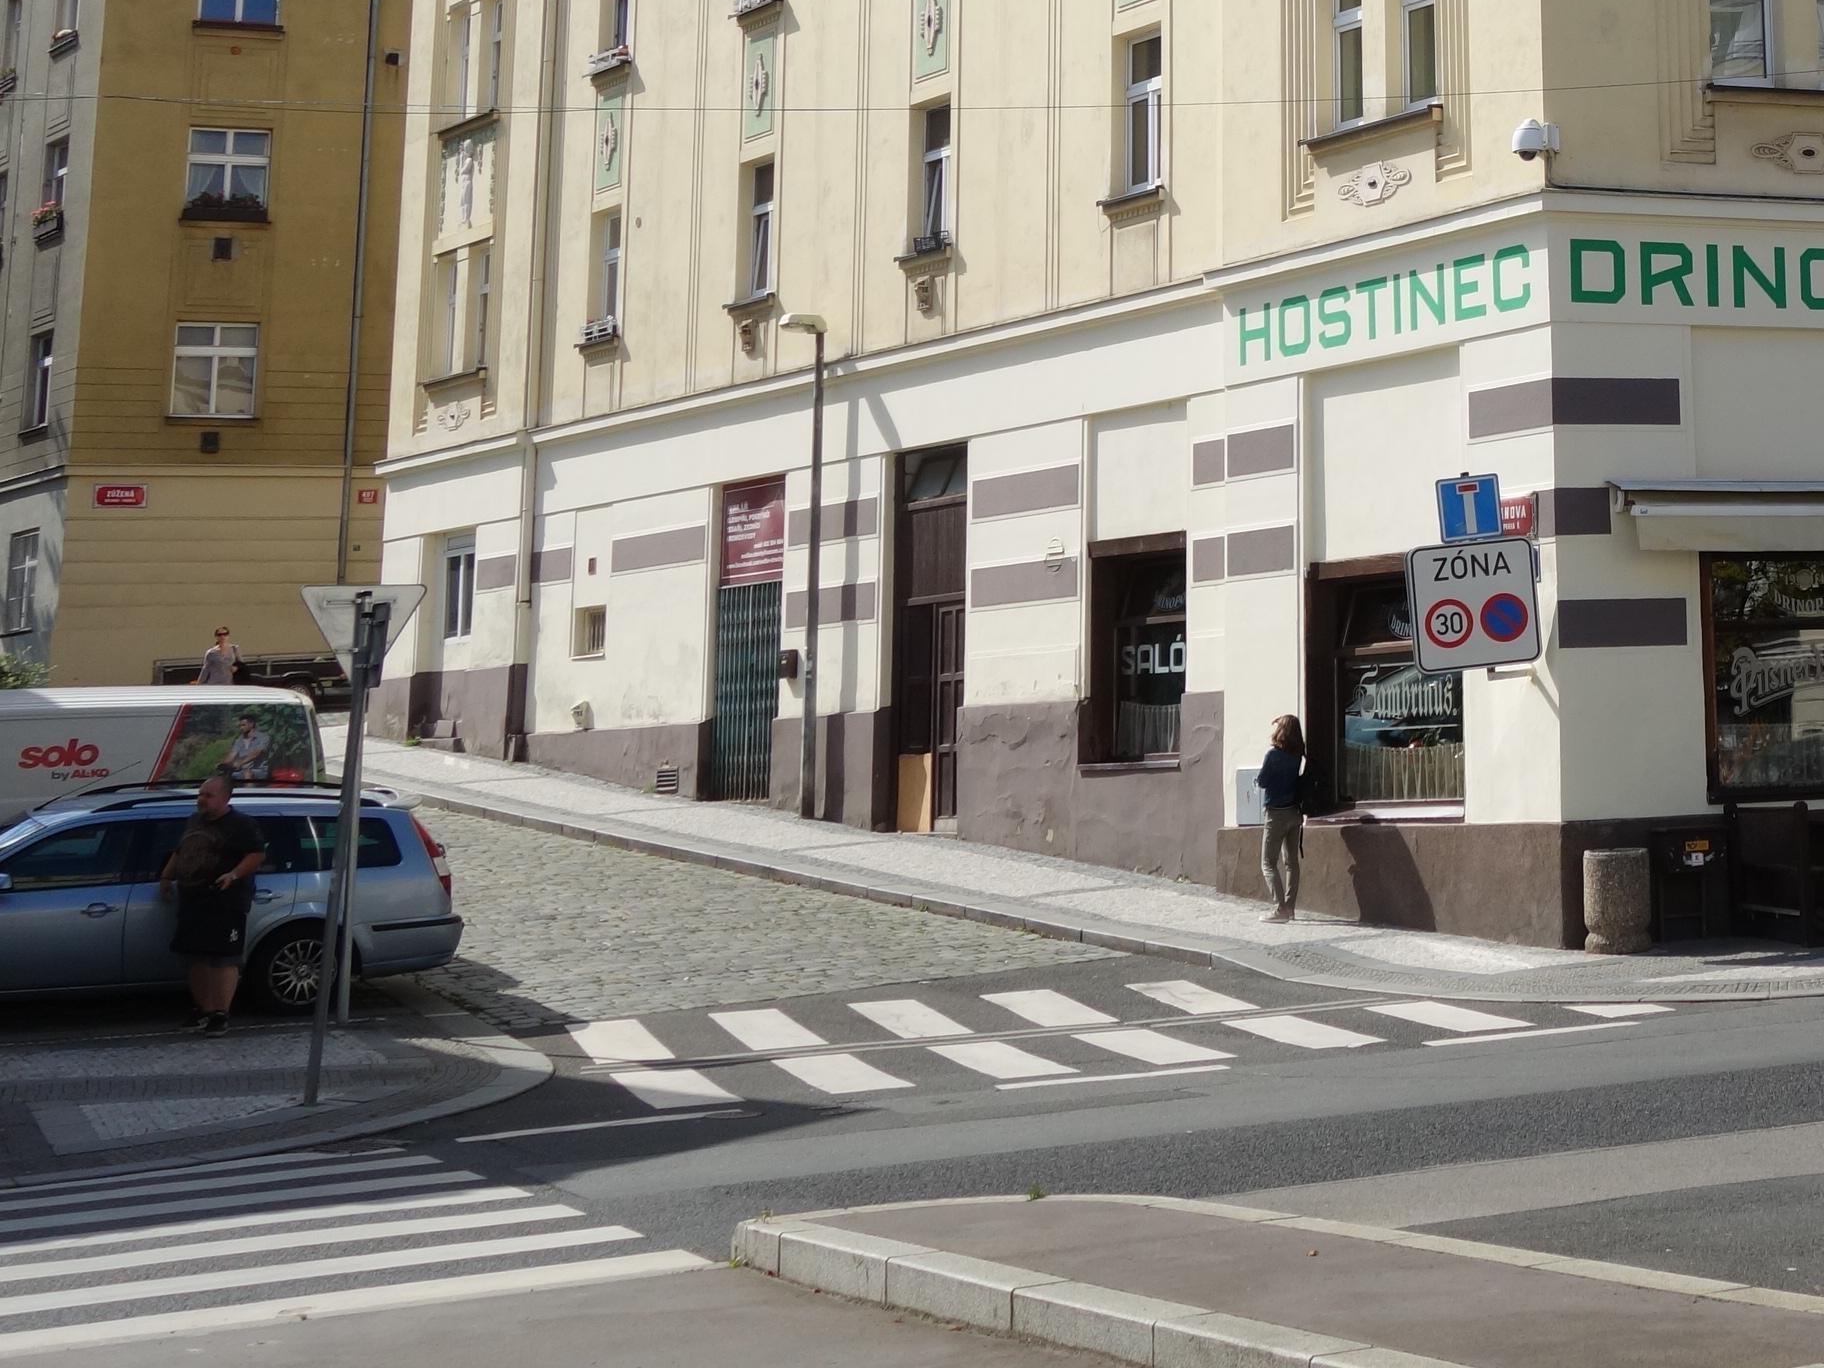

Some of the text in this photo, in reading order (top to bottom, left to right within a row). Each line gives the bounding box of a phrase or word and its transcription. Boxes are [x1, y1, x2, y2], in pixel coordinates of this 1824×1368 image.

[1240, 244, 1531, 366] HOSTINEC
[1432, 550, 1512, 582] ZÓNA
[1435, 611, 1464, 636] 30
[18, 738, 100, 769] solo
[51, 771, 70, 781] by
